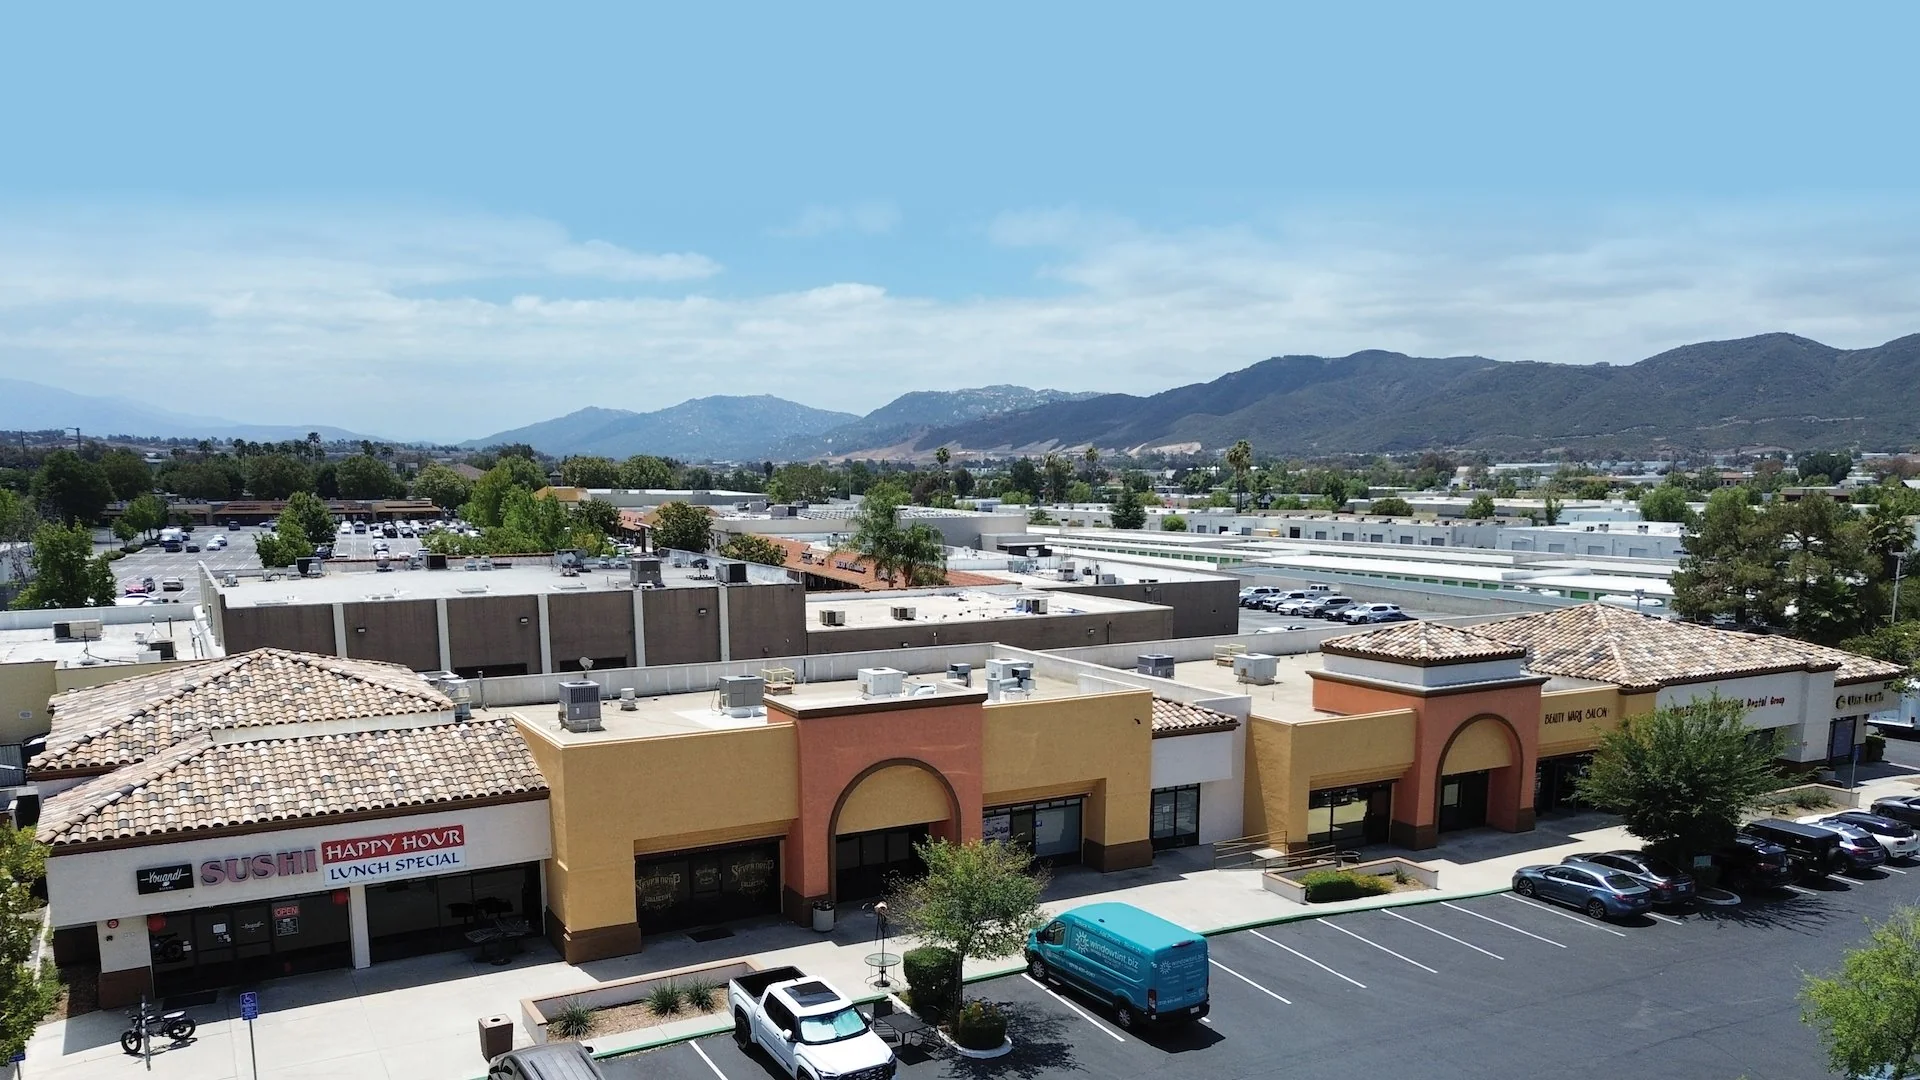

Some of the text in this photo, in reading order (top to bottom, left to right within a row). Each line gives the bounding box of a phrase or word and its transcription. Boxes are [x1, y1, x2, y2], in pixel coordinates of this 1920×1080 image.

[1770, 696, 1785, 708] Group
[1544, 712, 1565, 725] BEAUTY
[326, 829, 462, 860] HAPPY HOUR
[200, 848, 318, 886] SUSHI
[330, 852, 460, 880] LUNCH SPECIAL
[275, 906, 298, 917] OPEN
[1090, 939, 1139, 969] windowtint.biz
